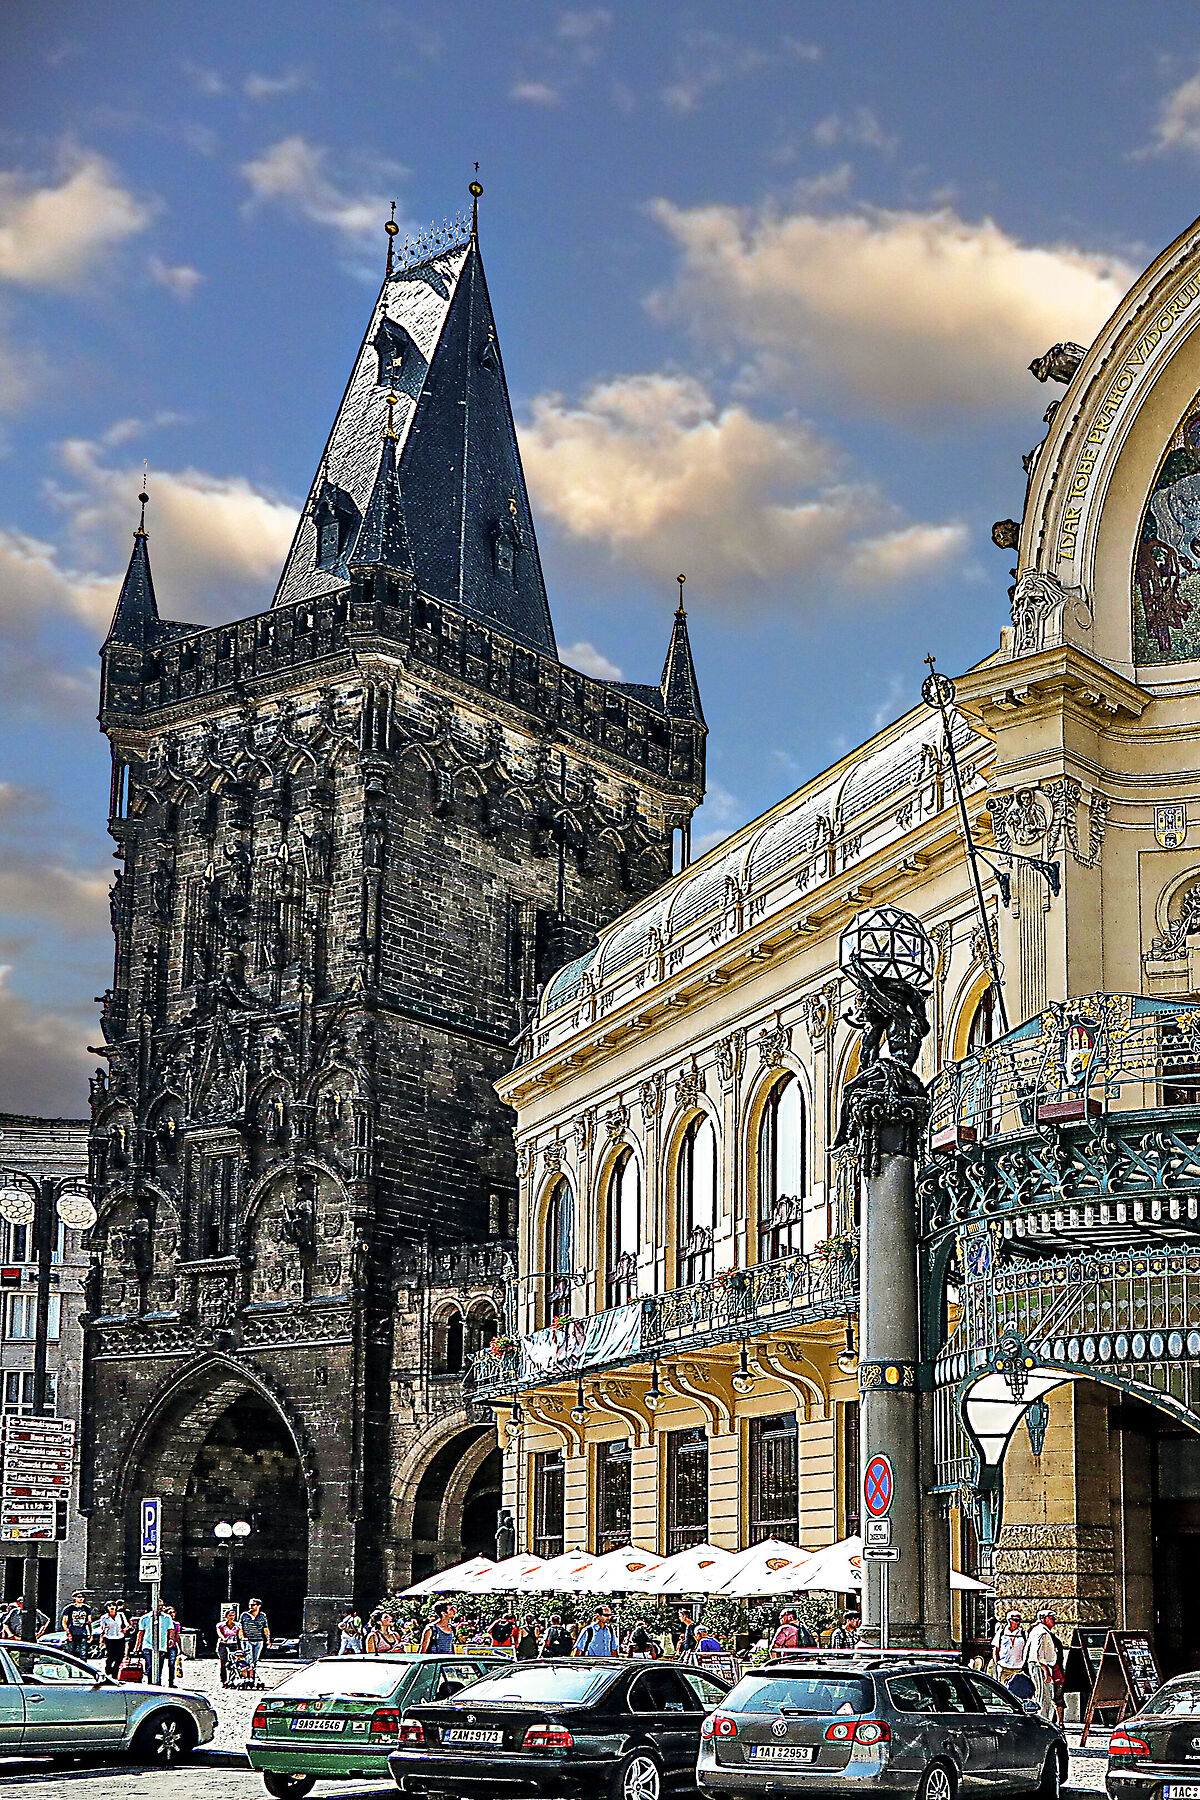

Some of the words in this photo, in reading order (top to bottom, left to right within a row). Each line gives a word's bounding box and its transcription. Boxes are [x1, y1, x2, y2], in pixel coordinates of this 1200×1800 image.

[1056, 505, 1082, 564] ZDAR
[1087, 366, 1137, 445] PRAHO!
[1125, 280, 1200, 365] VZDORUJ
[145, 1505, 156, 1538] P
[1172, 1786, 1193, 1798] 1AC
